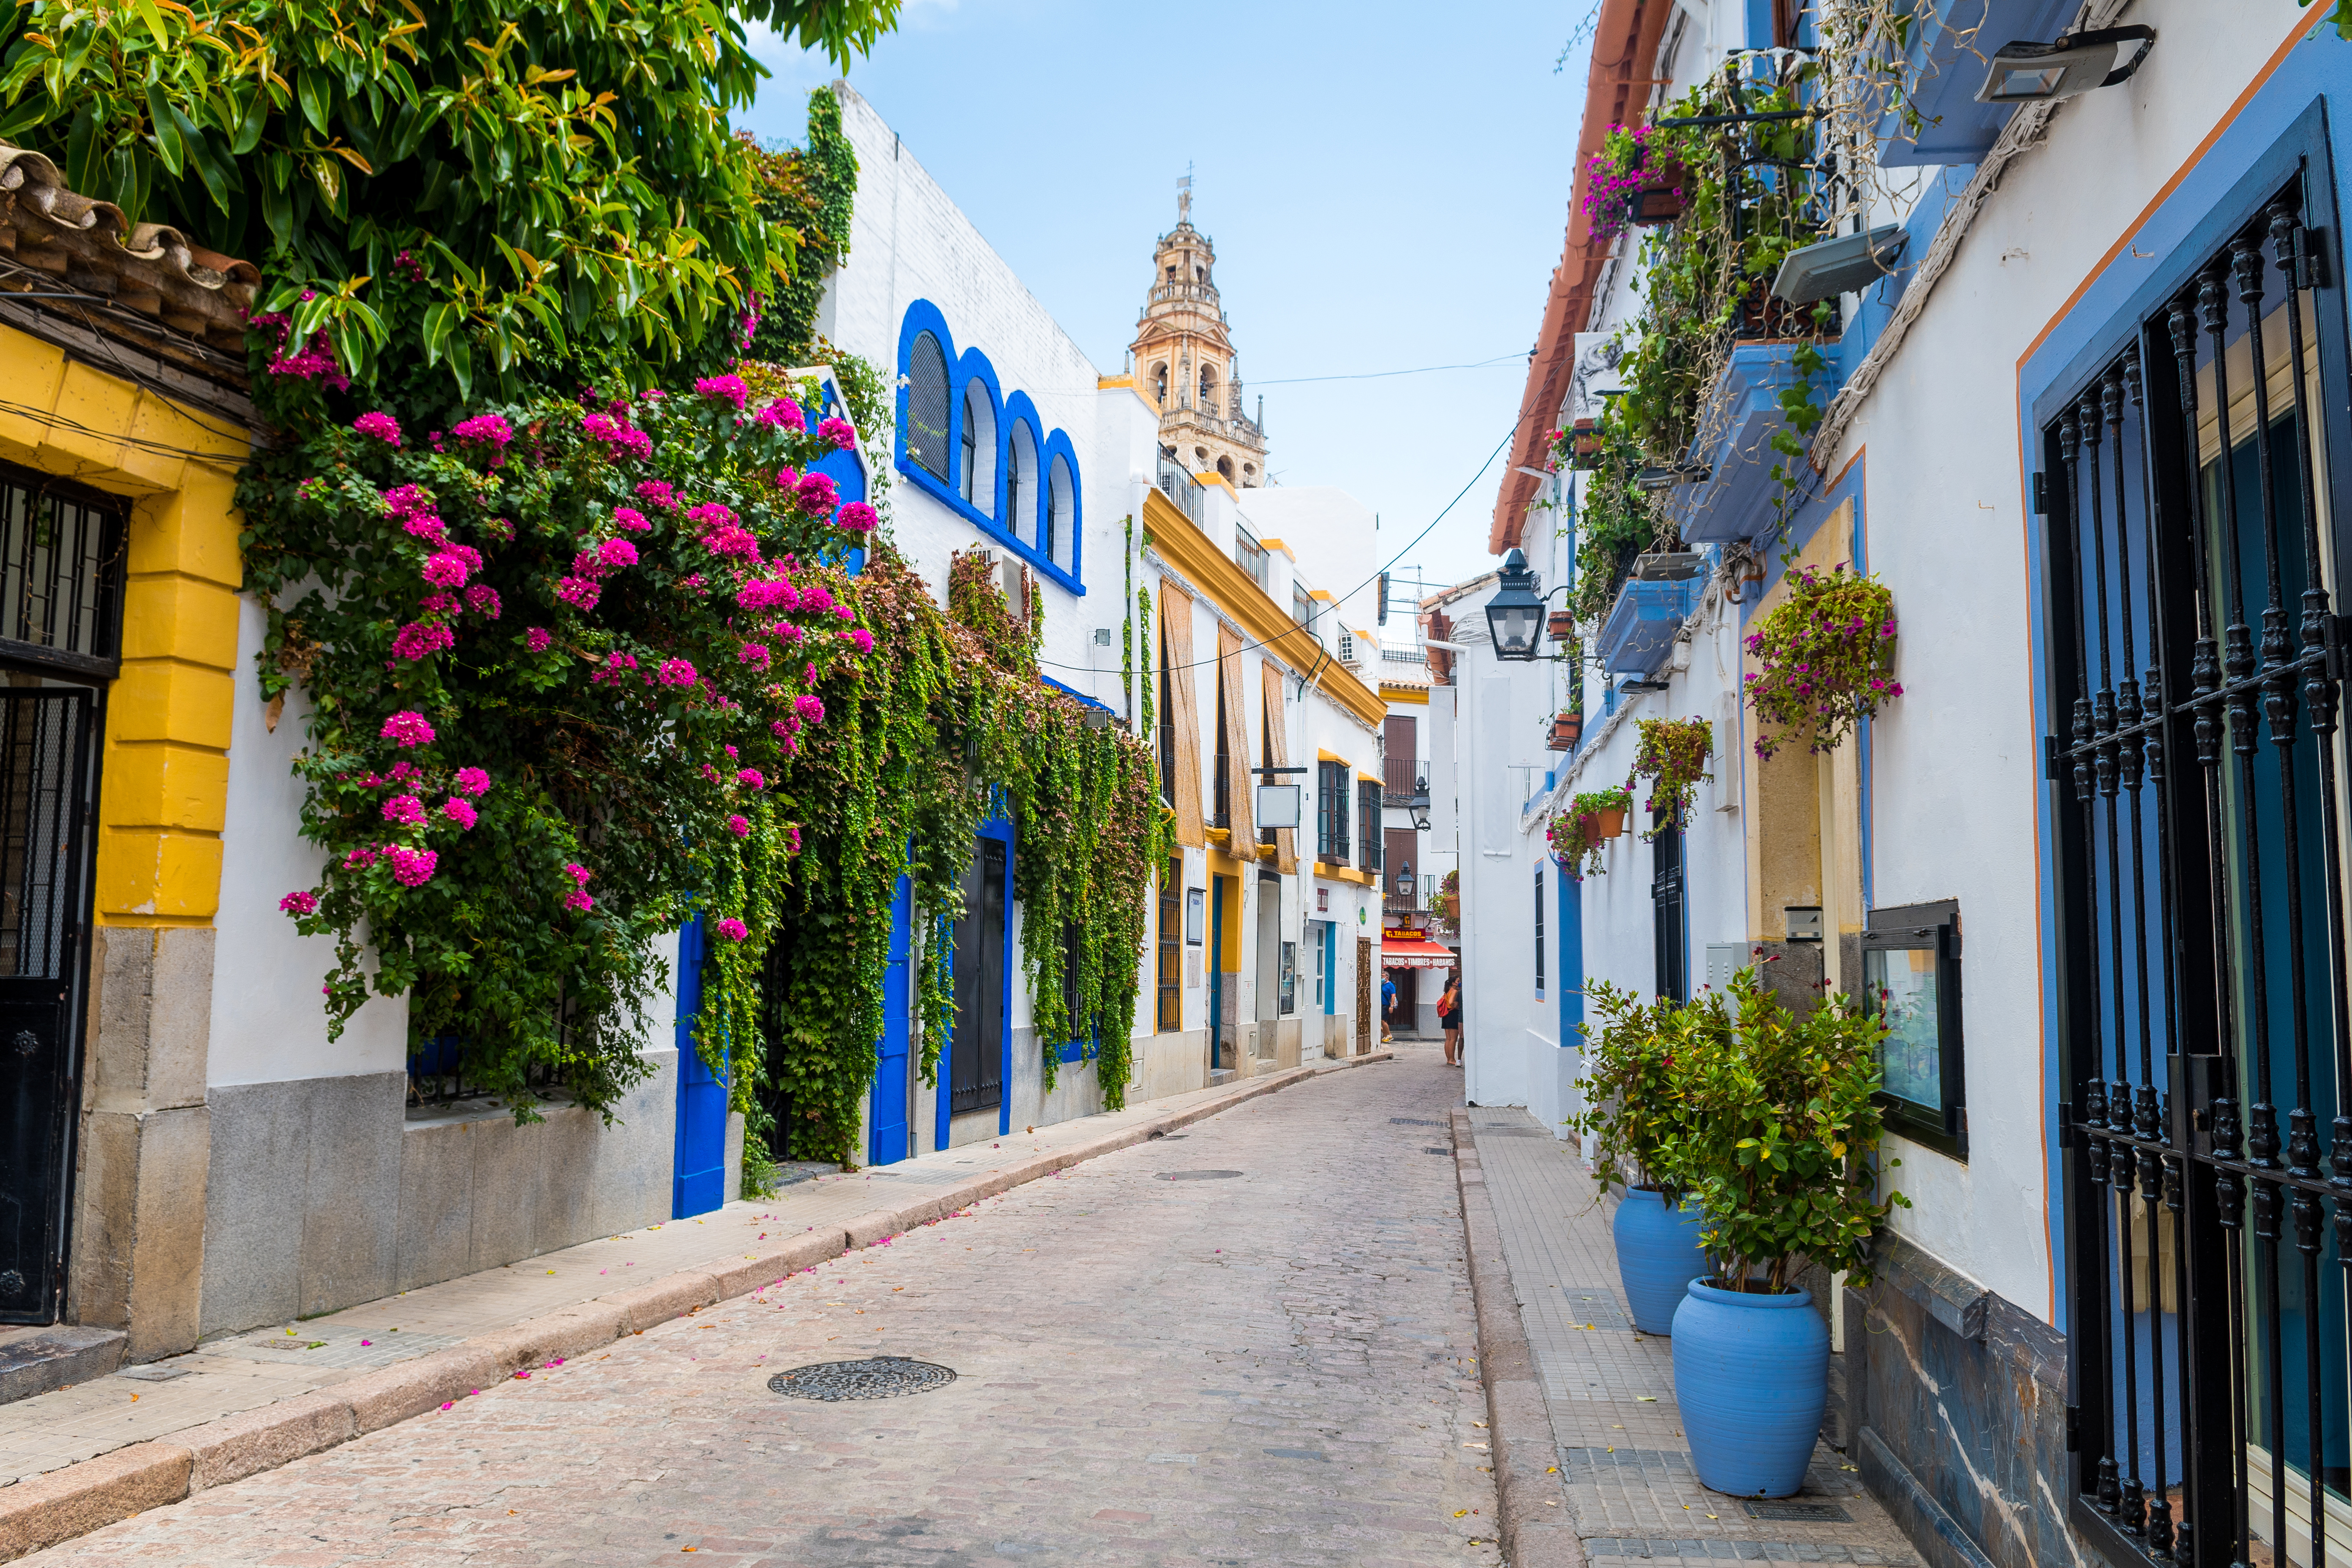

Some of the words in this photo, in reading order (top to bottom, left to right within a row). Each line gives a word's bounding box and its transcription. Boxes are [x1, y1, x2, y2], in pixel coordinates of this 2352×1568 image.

[1383, 957, 1405, 966] TABACOS
[1407, 958, 1430, 966] TIMBRES
[1432, 958, 1455, 966] HABANOS
